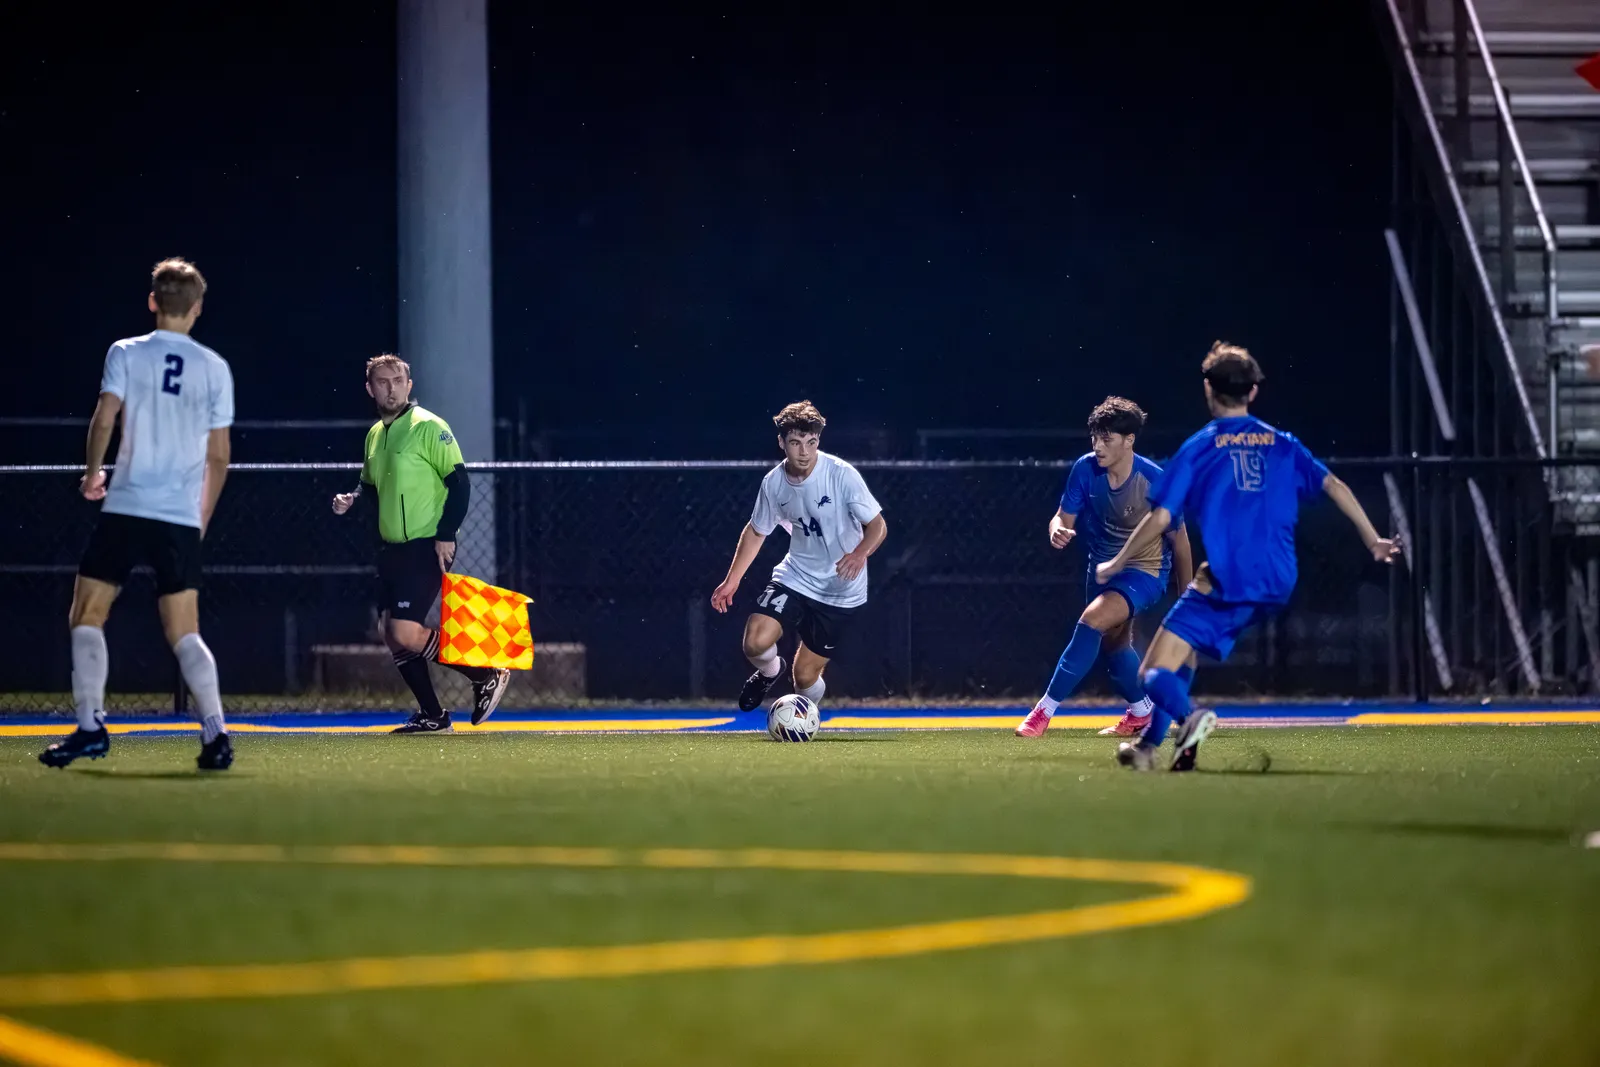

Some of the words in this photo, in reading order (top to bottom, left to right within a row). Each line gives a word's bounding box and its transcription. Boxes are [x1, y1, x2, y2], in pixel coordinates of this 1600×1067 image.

[162, 353, 184, 396] 2
[1229, 449, 1267, 491] 19
[798, 516, 823, 537] 14
[758, 589, 789, 614] 14
